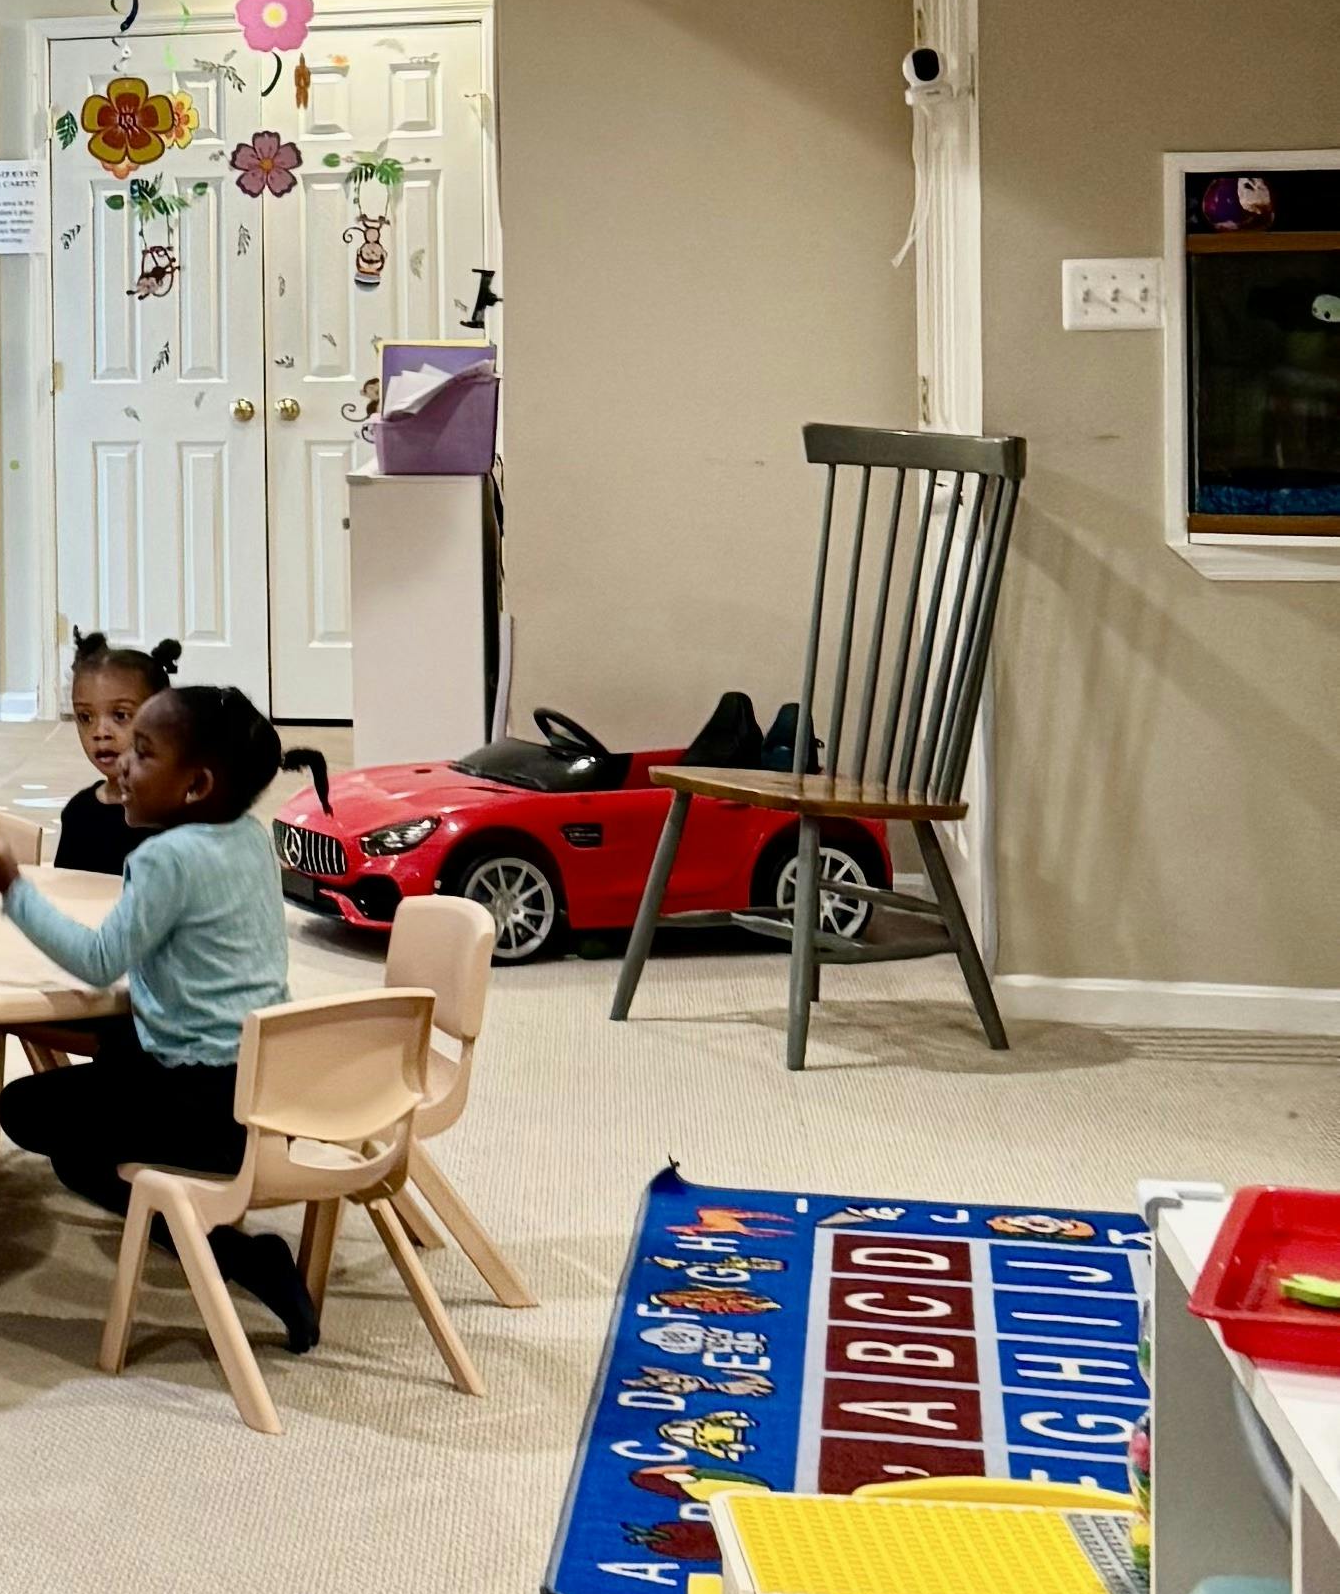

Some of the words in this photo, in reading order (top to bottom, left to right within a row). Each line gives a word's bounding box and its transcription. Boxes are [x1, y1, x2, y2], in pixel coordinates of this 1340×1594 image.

[674, 1235, 741, 1253] H
[850, 1247, 951, 1271] D
[685, 1266, 751, 1283] G
[1006, 1260, 1113, 1283] J
[636, 1303, 702, 1321] F
[844, 1292, 953, 1317] C
[702, 1352, 771, 1371] E
[846, 1341, 955, 1368] B
[1014, 1353, 1136, 1386] H
[617, 1391, 686, 1411] D
[839, 1401, 958, 1430] A
[1021, 1411, 1136, 1443] G
[610, 1440, 688, 1462] C
[597, 1562, 681, 1586] A
